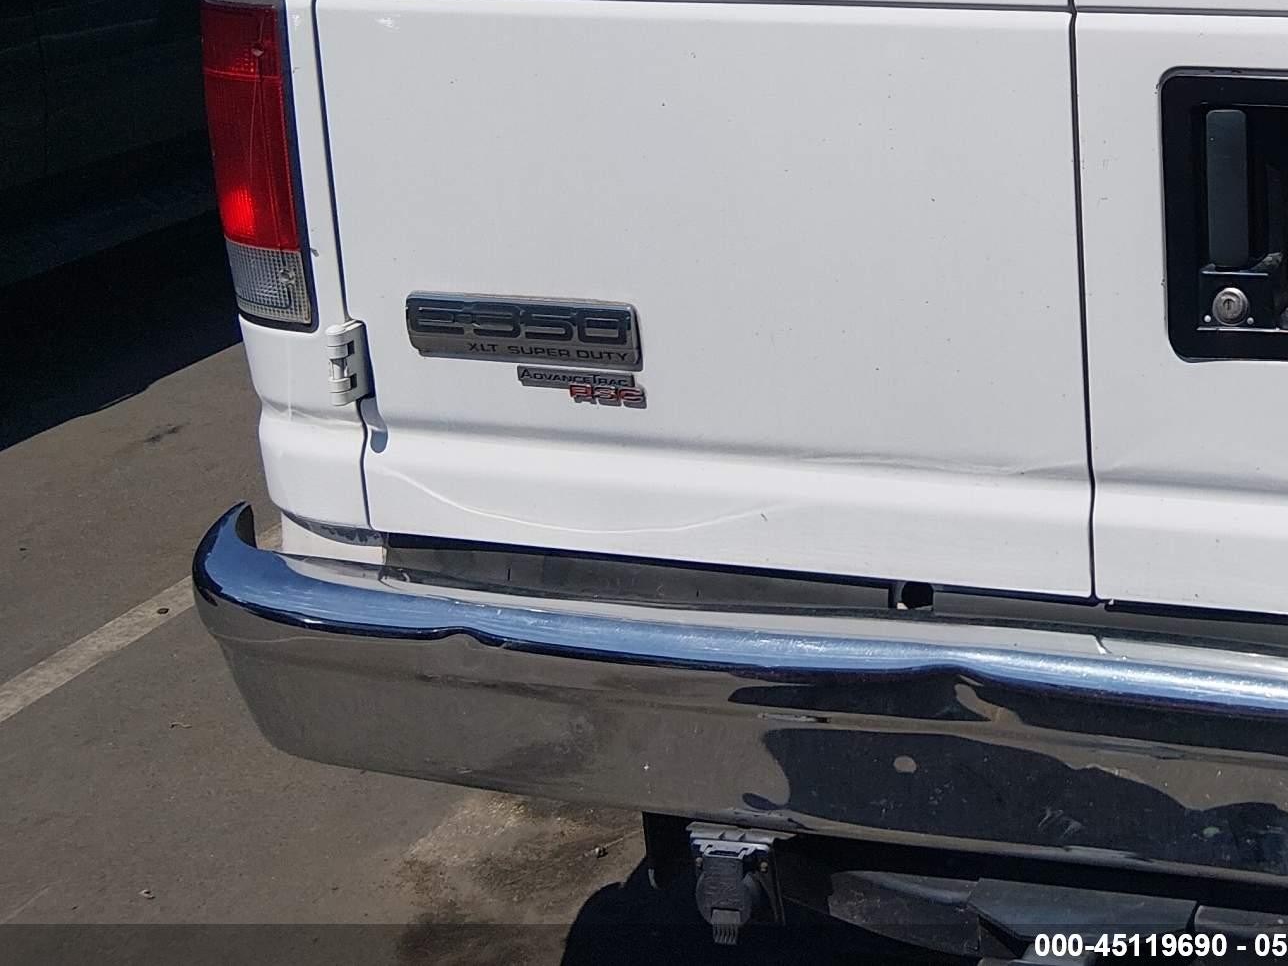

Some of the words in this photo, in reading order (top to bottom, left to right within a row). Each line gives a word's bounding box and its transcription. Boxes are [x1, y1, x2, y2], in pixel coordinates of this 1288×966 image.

[468, 342, 499, 353] XLT
[508, 345, 571, 359] SUPER
[576, 349, 628, 362] DUTY
